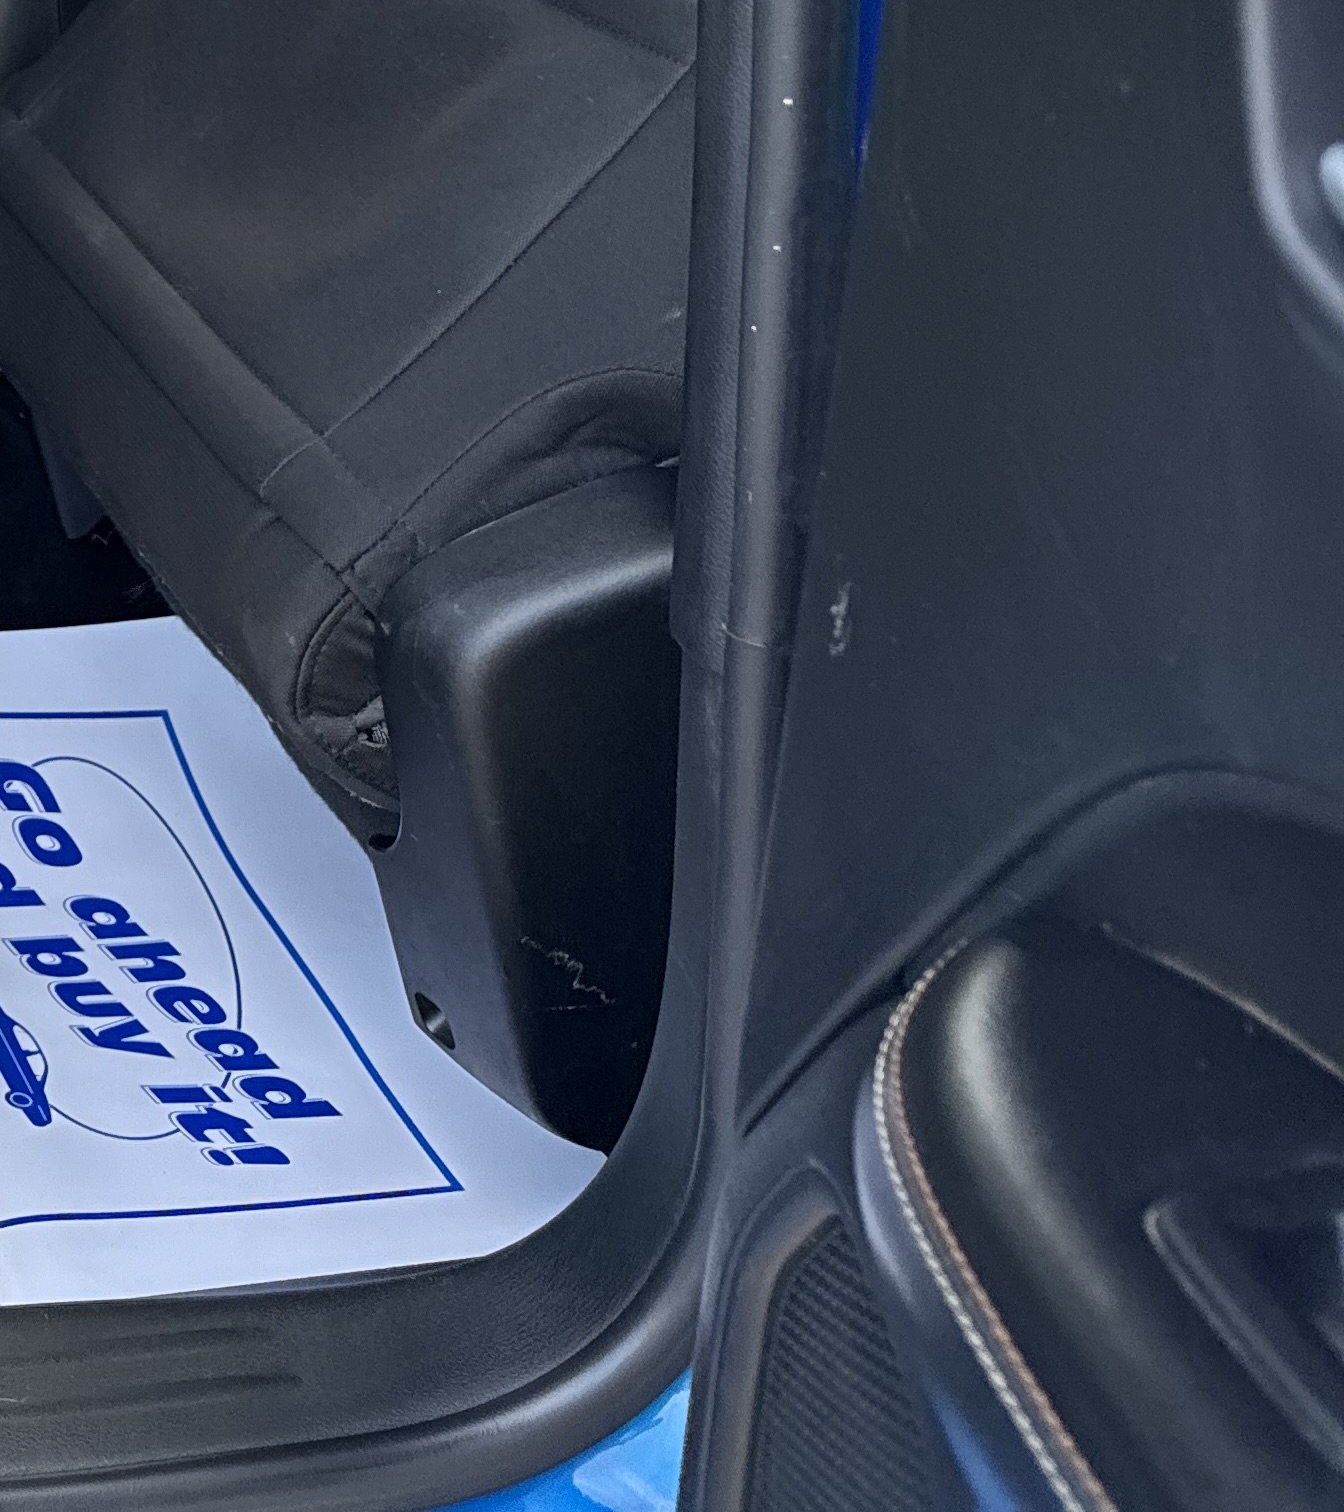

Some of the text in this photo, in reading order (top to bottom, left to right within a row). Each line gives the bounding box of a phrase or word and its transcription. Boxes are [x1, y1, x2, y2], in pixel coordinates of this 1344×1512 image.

[1, 935, 175, 1058] buy
[140, 1083, 291, 1166] it!
[63, 896, 343, 1120] ahead
